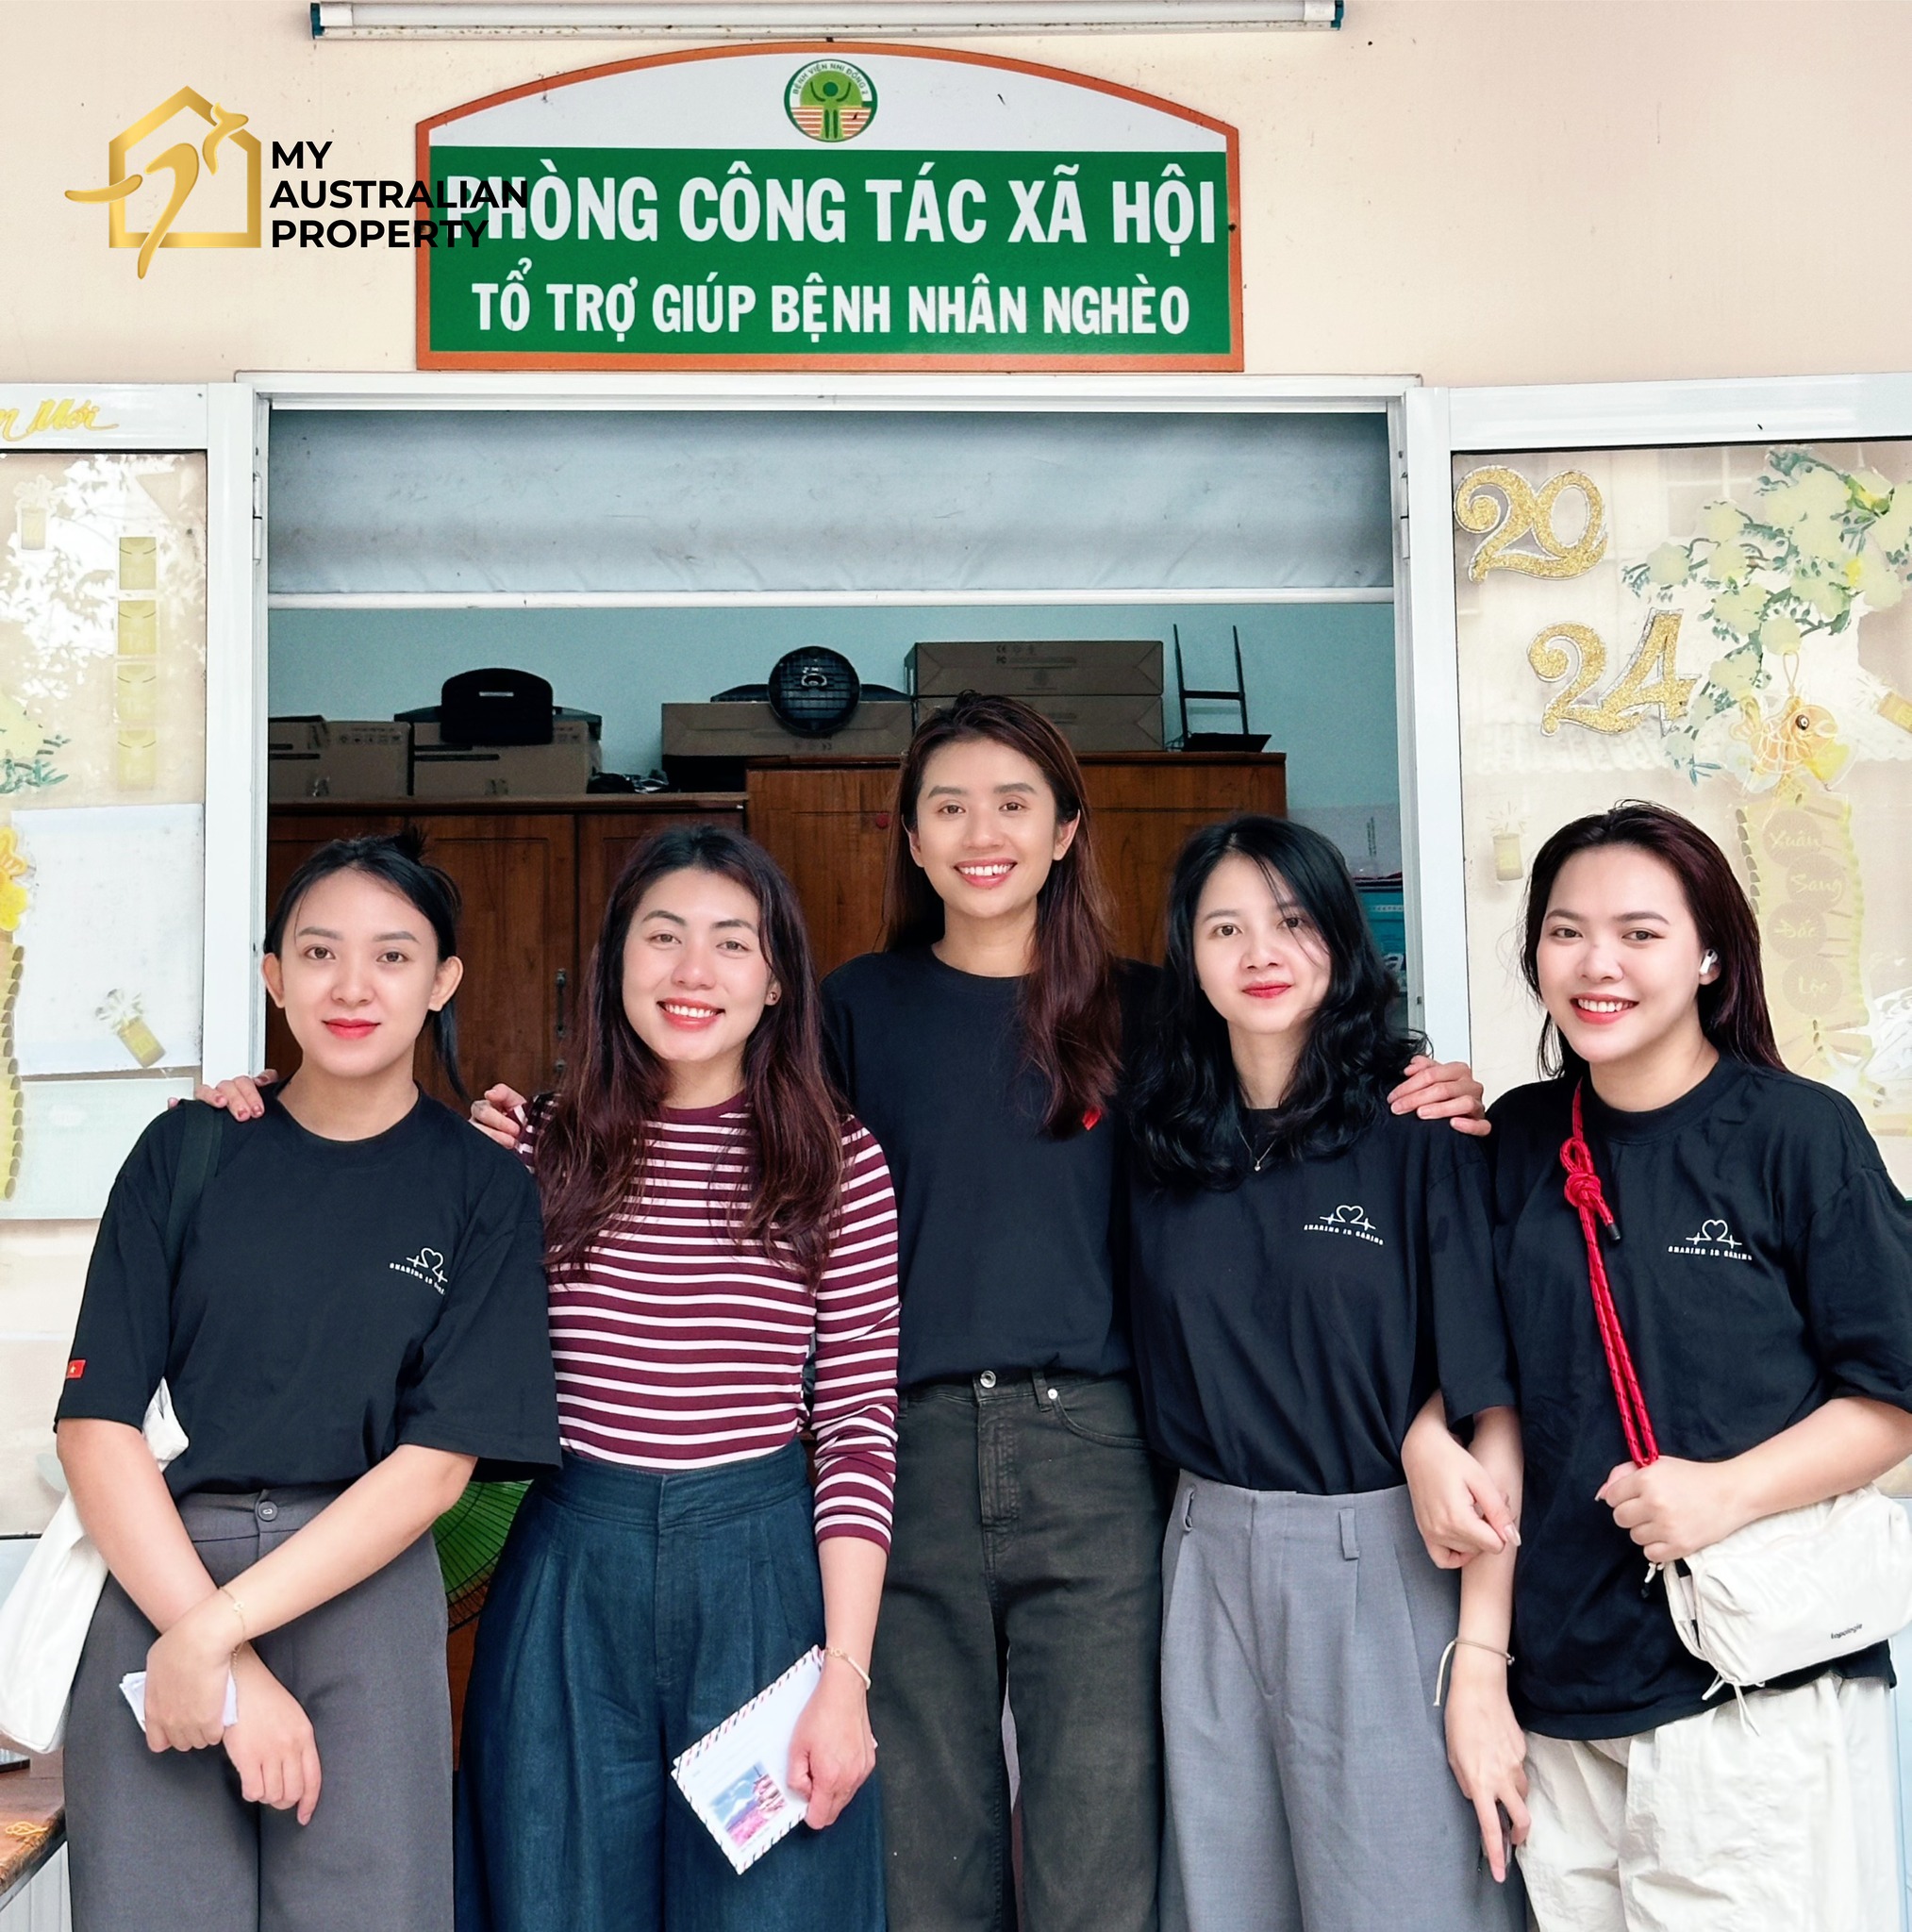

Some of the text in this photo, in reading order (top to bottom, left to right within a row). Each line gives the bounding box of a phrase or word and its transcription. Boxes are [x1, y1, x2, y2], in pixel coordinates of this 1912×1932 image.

[830, 62, 845, 72] NHI
[447, 158, 1215, 258] PHÒNG CÔNG TÁC XÃ HỘI
[472, 257, 1189, 343] TỔ TRỢ GIÚP BỆNH NHÂN NGHÈO
[1454, 465, 1608, 583] 20
[1528, 608, 1702, 737] 24
[1791, 874, 1843, 902] Sang
[1798, 975, 1828, 995] Lộc
